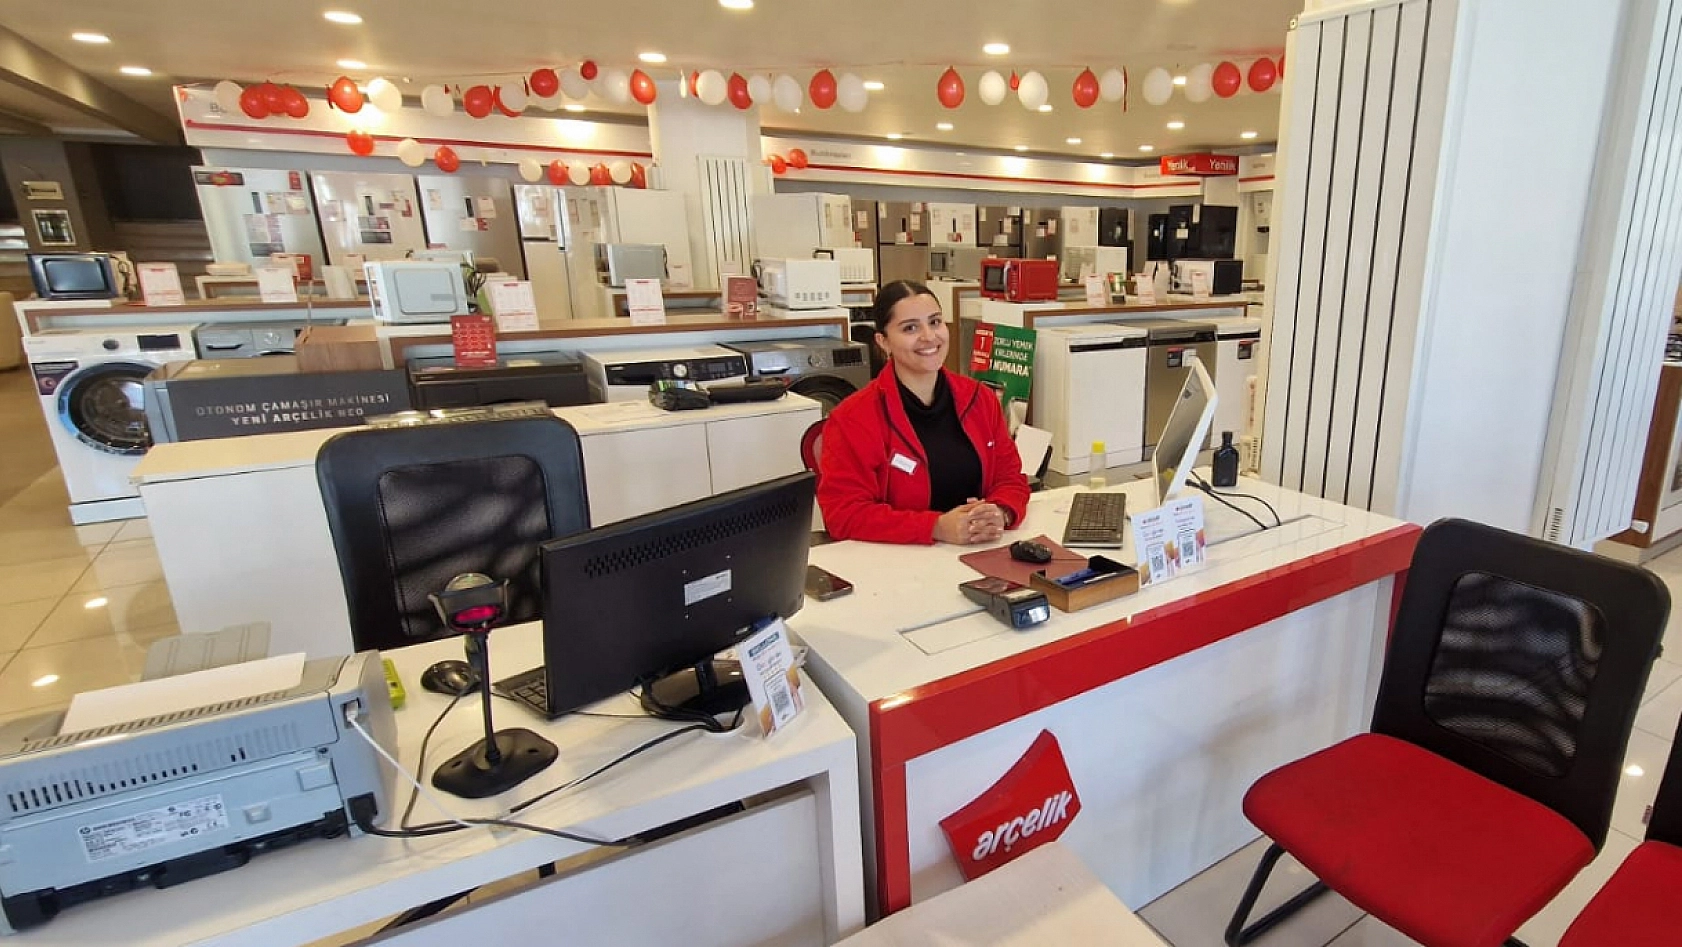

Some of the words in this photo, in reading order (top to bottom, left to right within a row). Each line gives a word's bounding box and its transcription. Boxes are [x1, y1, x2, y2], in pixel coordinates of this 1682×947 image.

[195, 403, 257, 416] OTONOM
[262, 399, 323, 412] ÇAMAŞIR
[328, 392, 389, 407] MAKİNESİ
[231, 413, 267, 425] YENİ
[273, 409, 333, 424] ARÇELİK
[972, 791, 1073, 861] arçelik
